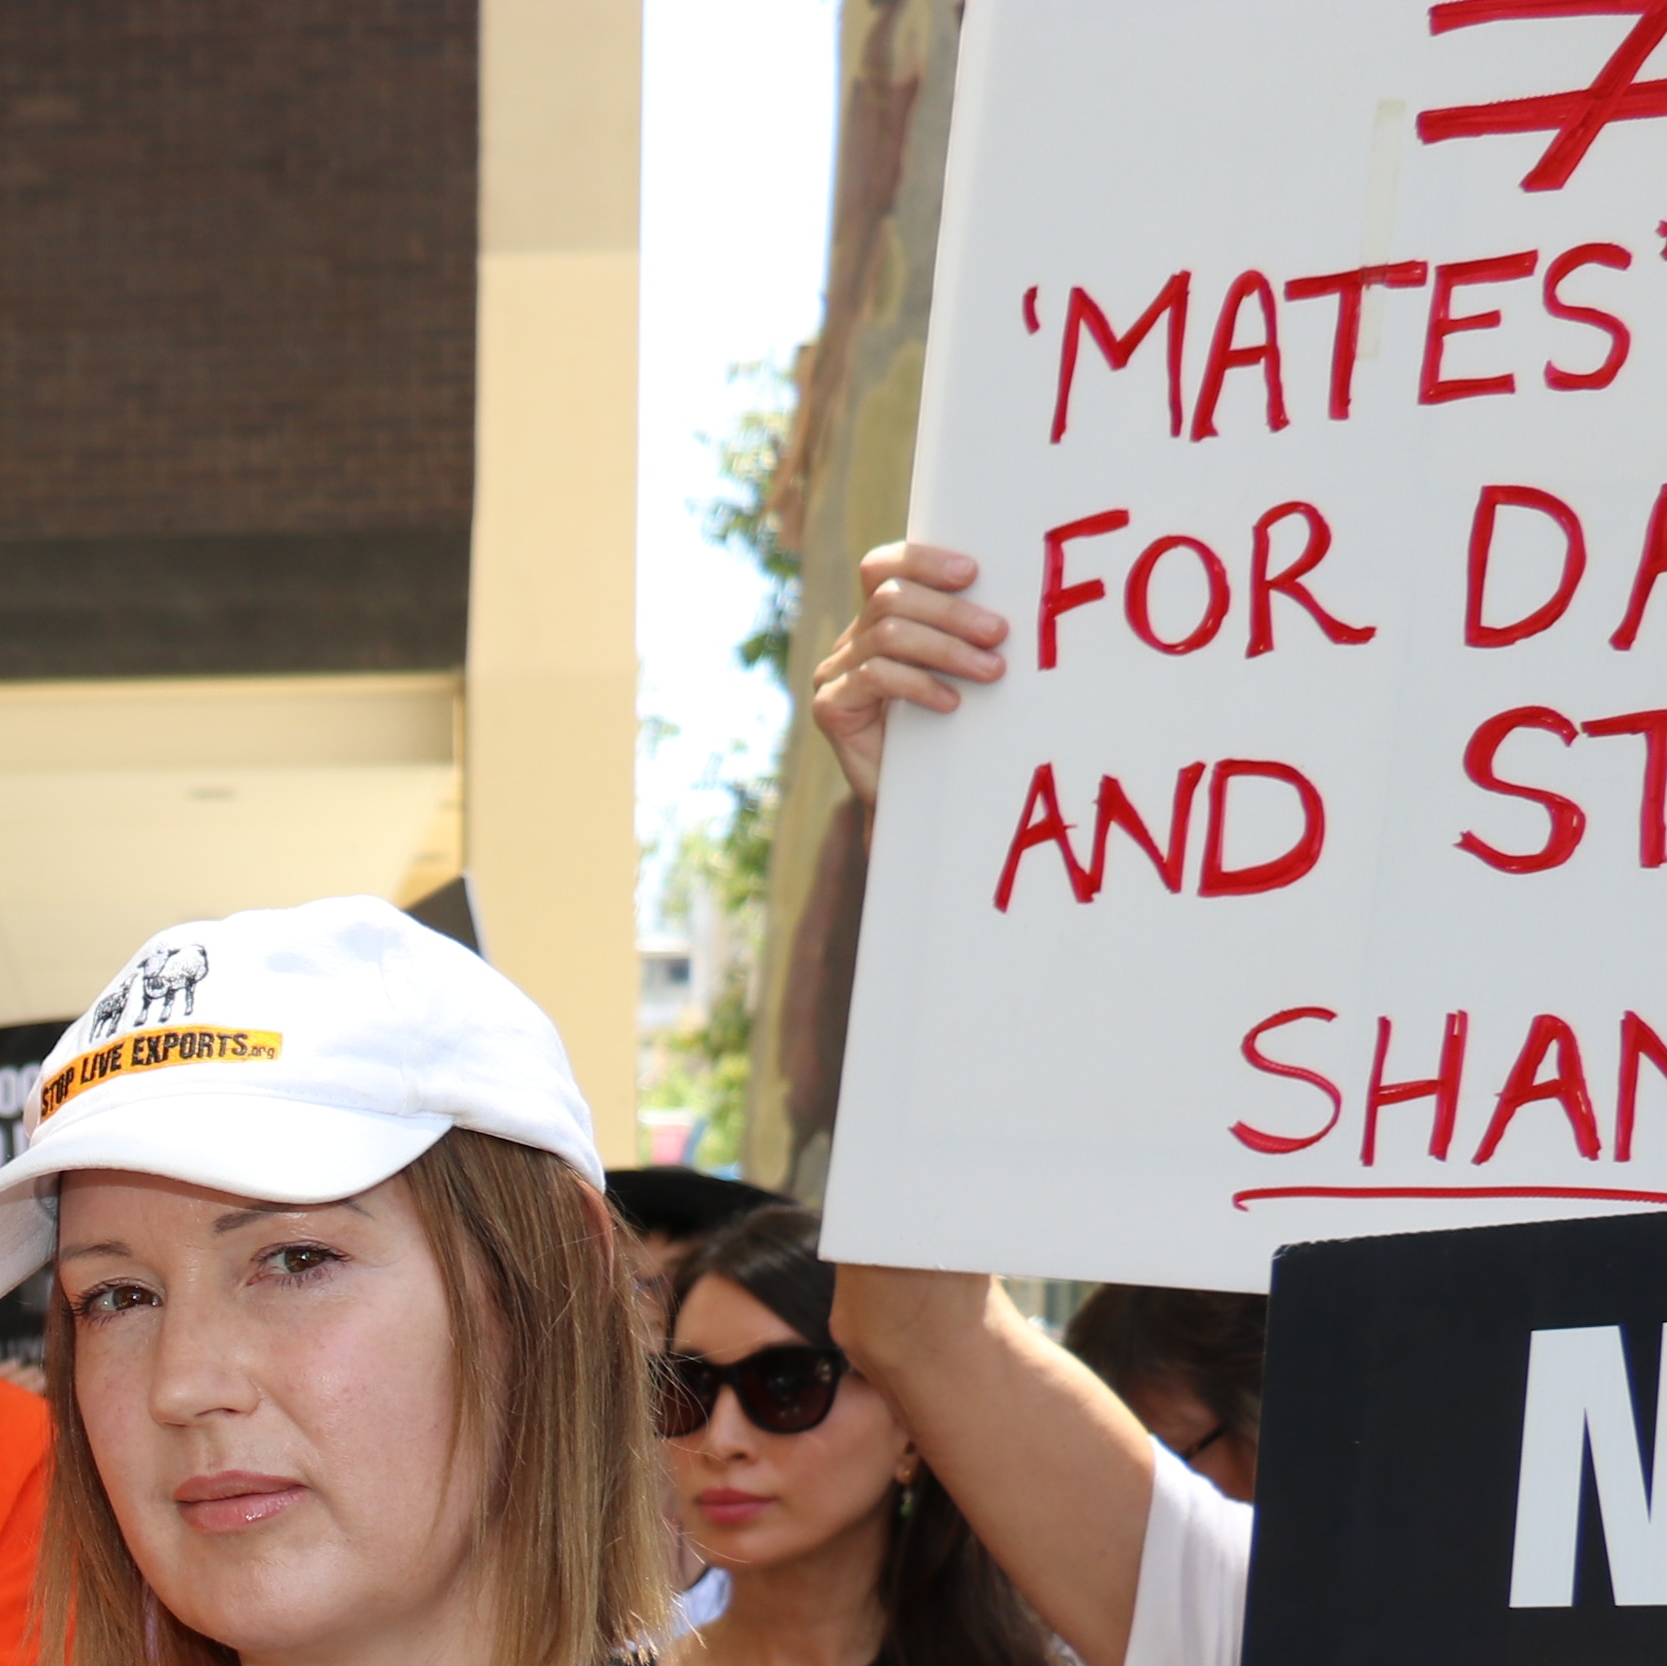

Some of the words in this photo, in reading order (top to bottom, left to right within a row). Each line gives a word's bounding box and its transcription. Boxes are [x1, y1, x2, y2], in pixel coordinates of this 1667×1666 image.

[1037, 501, 1376, 671] FOR
[993, 758, 1324, 913] AND
[41, 1067, 74, 1115] STOP
[80, 1042, 123, 1085] LIVE
